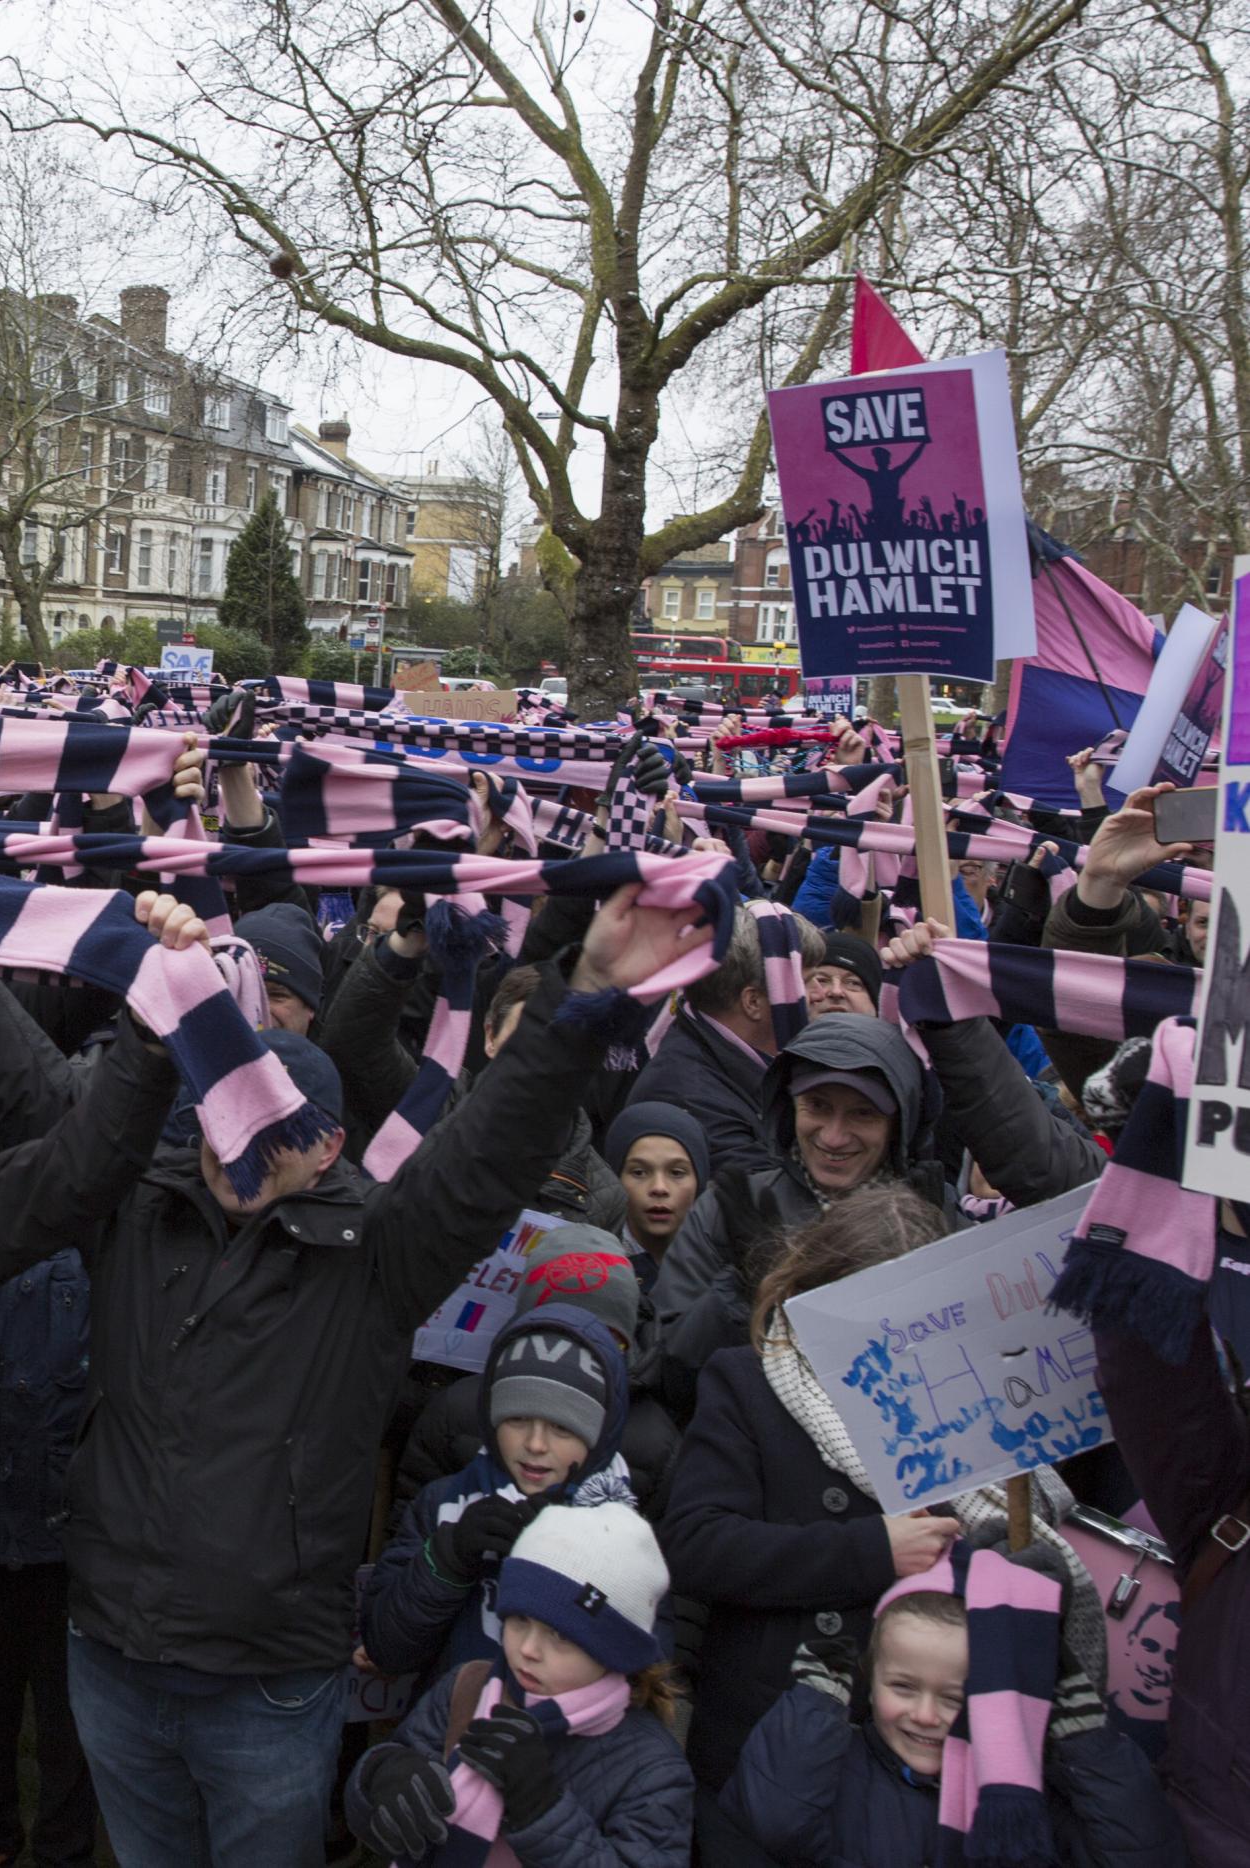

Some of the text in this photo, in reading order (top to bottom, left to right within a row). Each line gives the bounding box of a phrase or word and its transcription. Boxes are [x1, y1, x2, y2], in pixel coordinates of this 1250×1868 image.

[825, 392, 926, 444] SAVE
[803, 538, 981, 580] DULWICH
[807, 576, 982, 618] HAMLET
[423, 699, 501, 723] HANDS
